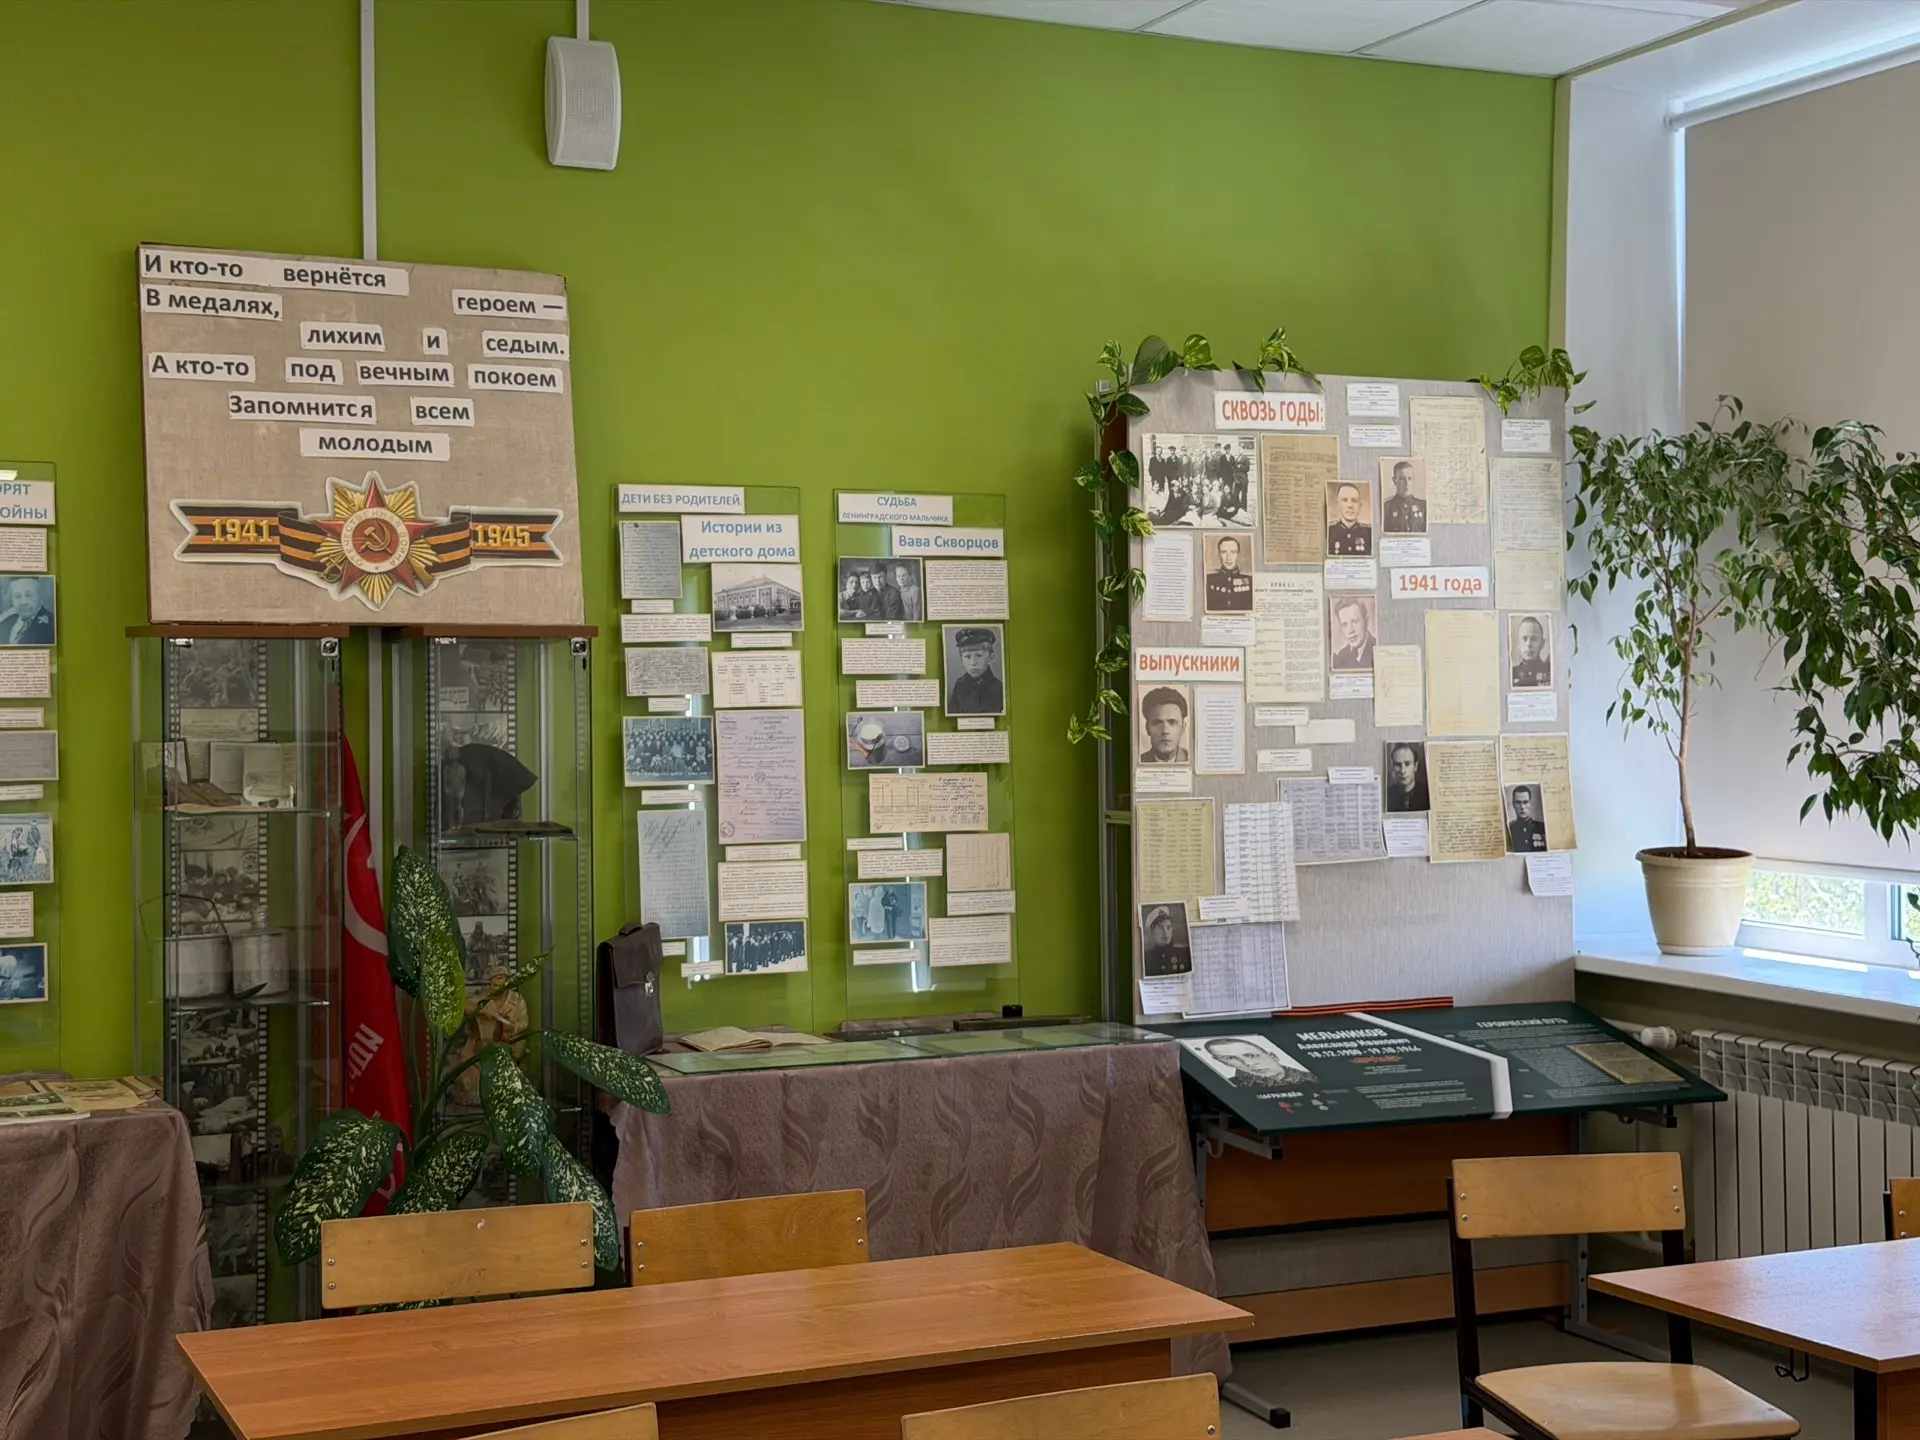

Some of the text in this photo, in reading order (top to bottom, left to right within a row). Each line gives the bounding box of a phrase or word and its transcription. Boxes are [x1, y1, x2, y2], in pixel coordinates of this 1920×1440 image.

[145, 254, 387, 288] И кто-то вернётся
[146, 288, 161, 307] В
[168, 293, 280, 318] медалях,
[457, 296, 536, 315] героем
[307, 328, 565, 356] лихим и седым.
[151, 354, 557, 388] А кто-то под вечным покоем
[229, 394, 471, 421] Запомнится всем
[1222, 400, 1276, 421] СКВОЗЬ
[318, 434, 433, 454] молодым
[622, 493, 741, 507] ДЕТИ БЕЗ РОДИТЕЛЕЙ
[876, 496, 917, 508] СУДЬБА
[211, 518, 532, 548] 1941 1945
[701, 519, 782, 536] Истории из
[899, 534, 999, 551] Вава Скворцов
[689, 547, 796, 559] детского дома
[1399, 574, 1482, 594] 1941 года
[1296, 1028, 1388, 1041] МЕЛЬНИКОВ
